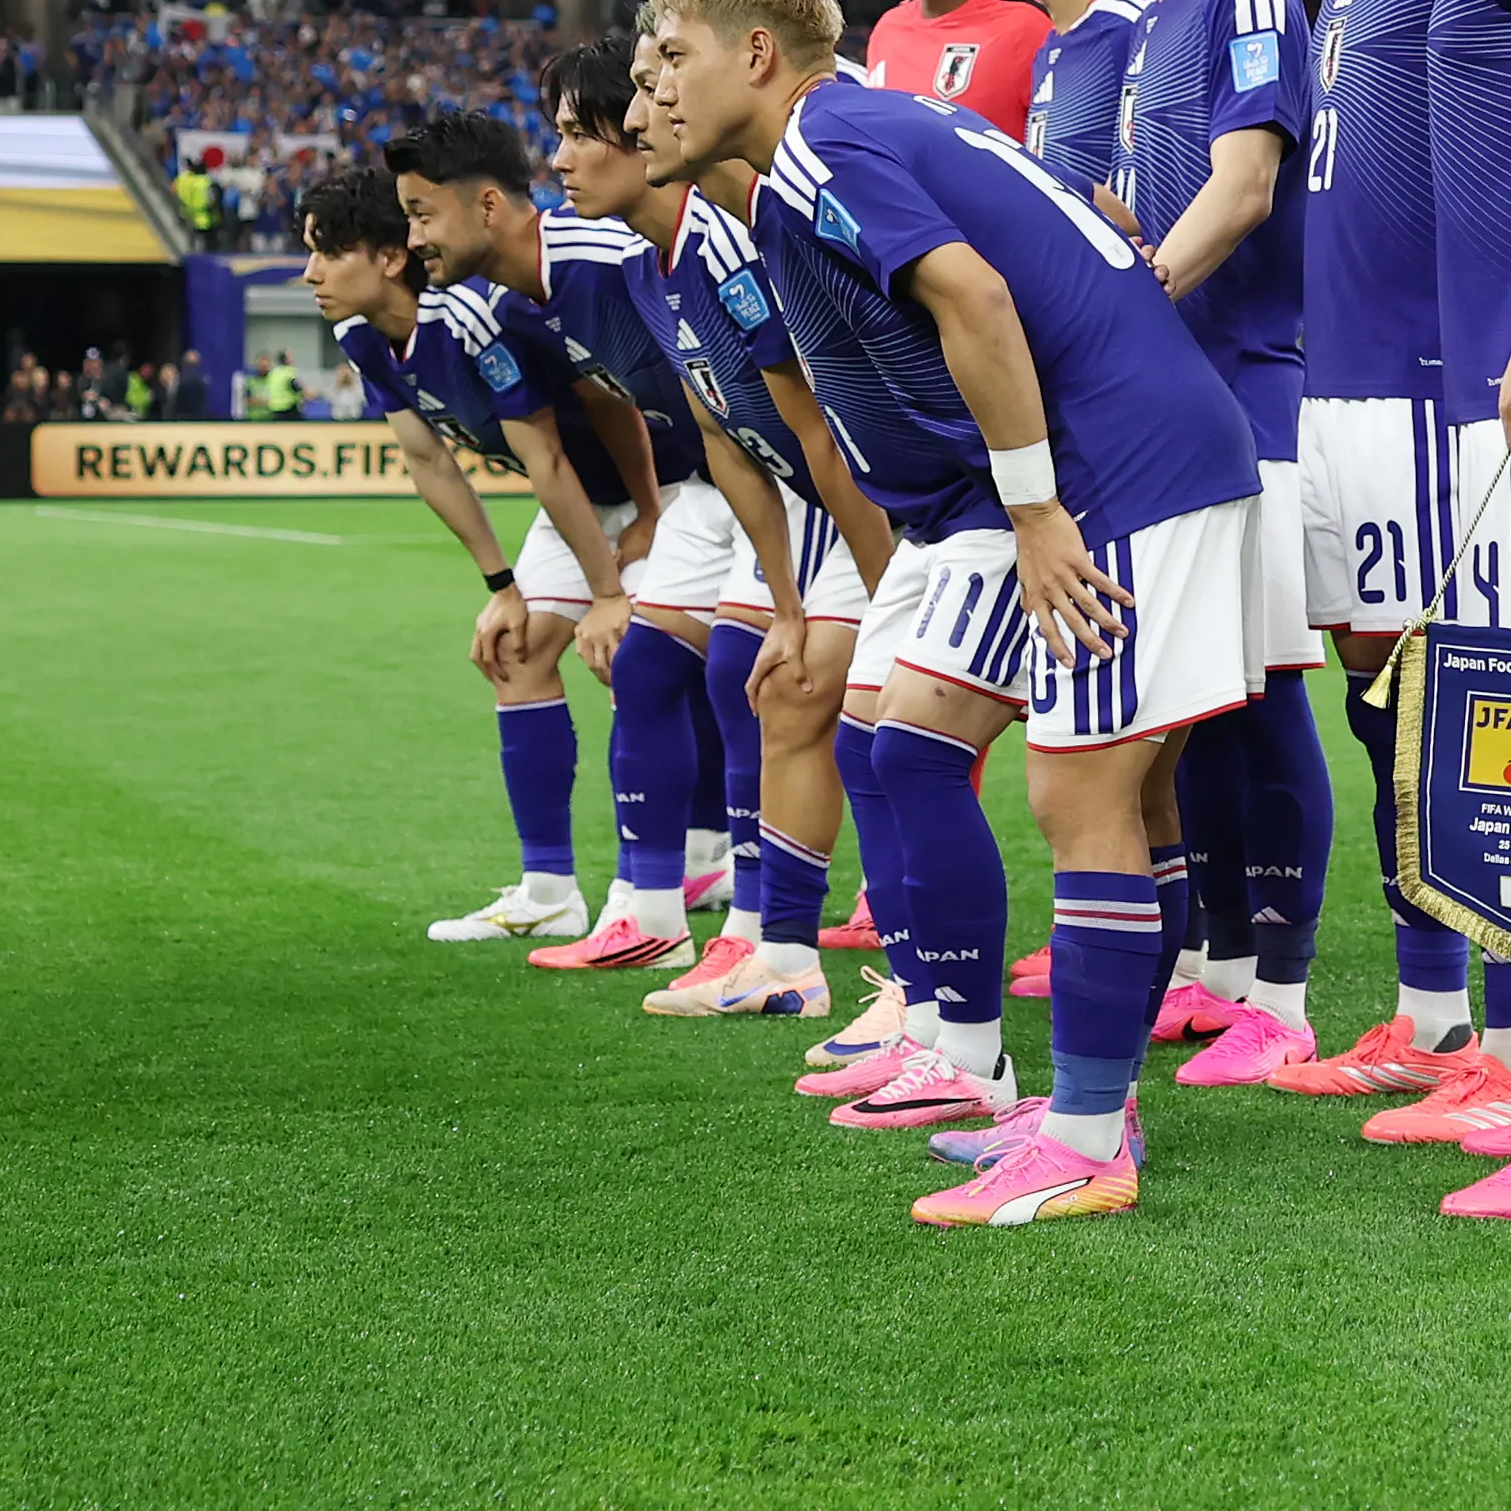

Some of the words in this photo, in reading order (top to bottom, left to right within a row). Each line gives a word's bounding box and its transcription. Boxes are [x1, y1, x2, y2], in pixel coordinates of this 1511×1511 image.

[1307, 108, 1338, 192] 21
[1355, 519, 1407, 604] 21
[1443, 653, 1486, 672] Japan
[1481, 803, 1502, 815] FIFA
[1469, 817, 1510, 835] Japan
[1498, 840, 1510, 850] 25
[1483, 853, 1510, 865] Dallas
